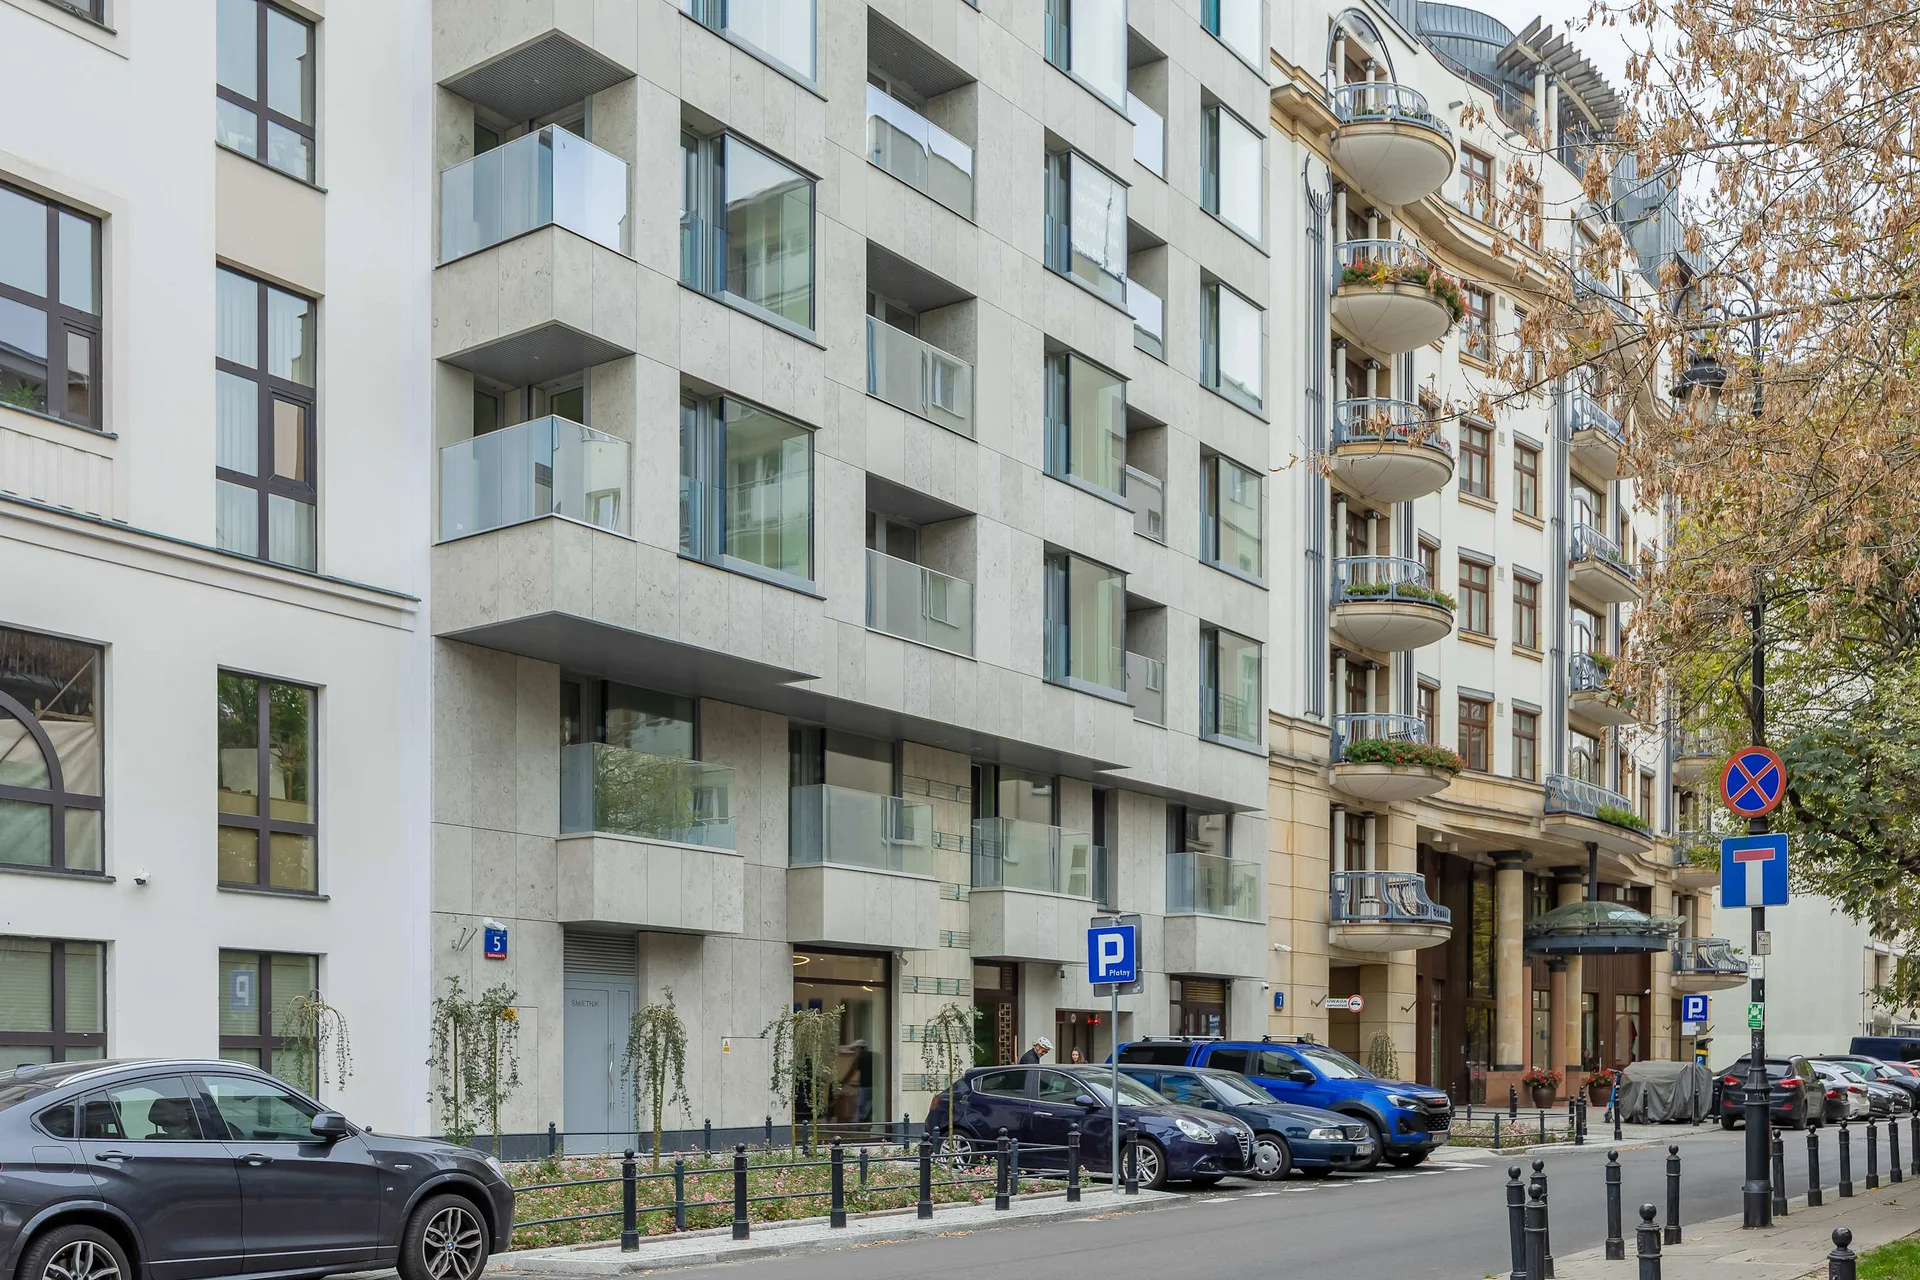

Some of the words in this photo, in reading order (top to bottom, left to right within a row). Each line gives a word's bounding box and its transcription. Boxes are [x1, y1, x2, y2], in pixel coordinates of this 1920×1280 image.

[493, 936, 501, 951] 5
[1098, 933, 1124, 977] P
[1109, 969, 1130, 977] Płatny
[571, 997, 599, 1007] ŚMIETNIK
[1688, 998, 1703, 1019] P
